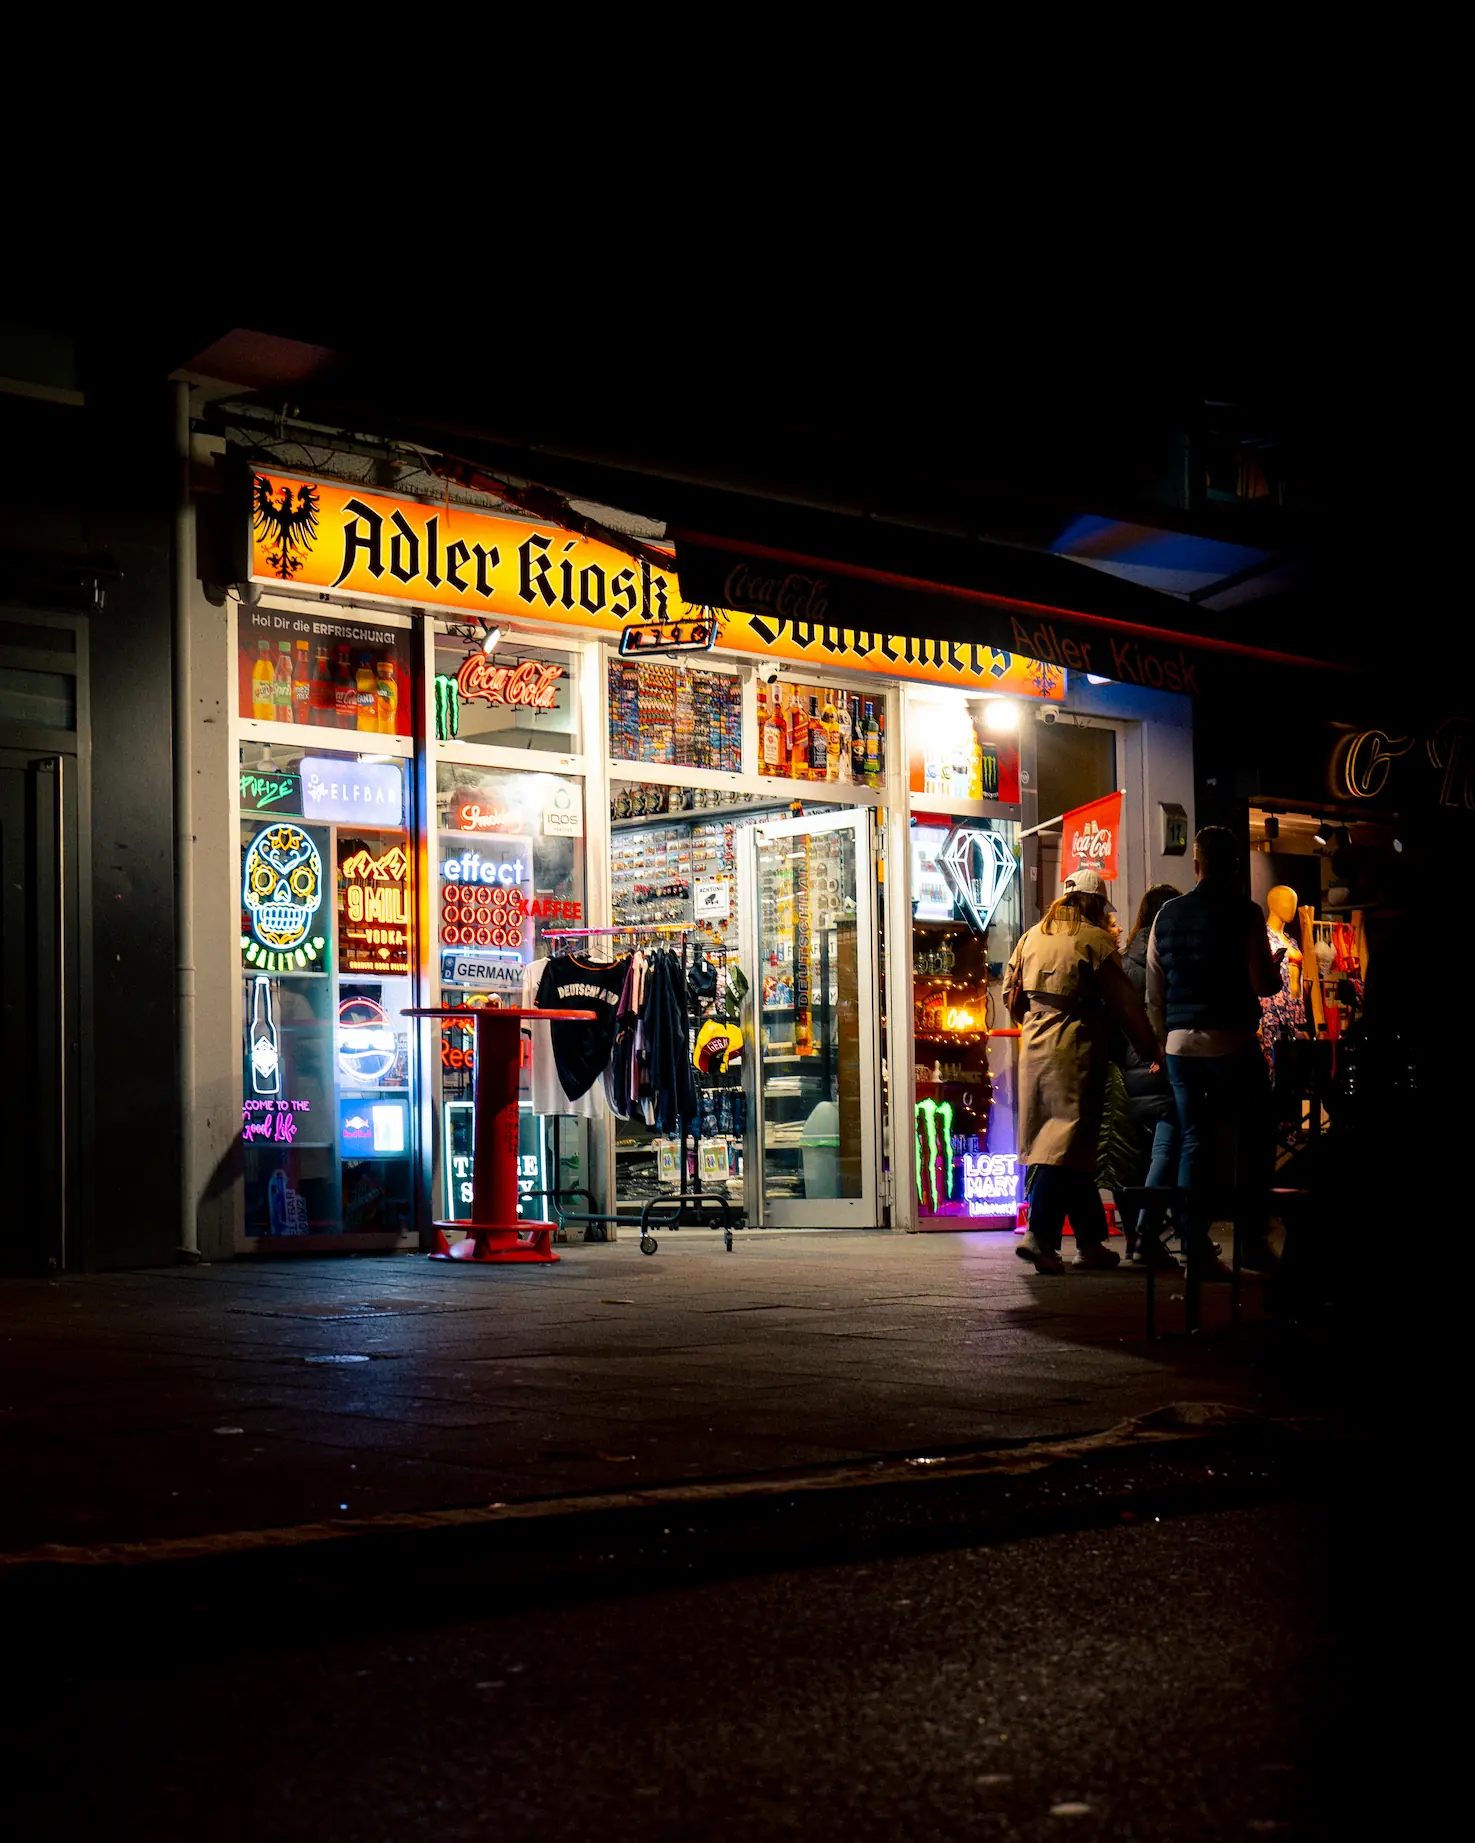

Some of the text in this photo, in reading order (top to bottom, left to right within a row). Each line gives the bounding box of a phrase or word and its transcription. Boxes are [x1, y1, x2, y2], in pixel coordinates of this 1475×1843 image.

[330, 497, 669, 621] Adler Kiosk
[252, 613, 396, 645] Hol Dir die ERFRISCHUNG!
[1009, 614, 1203, 698] Adler Kiosk
[547, 813, 579, 825] IQOS
[444, 852, 524, 884] effect
[347, 884, 364, 923] 9
[517, 898, 582, 920] KAFFEE
[365, 929, 403, 945] VODKA
[246, 940, 318, 972] SALITOS
[457, 962, 523, 982] GERMANY
[276, 1100, 289, 1111] TO
[290, 1100, 311, 1111] THE
[966, 1154, 1018, 1176] LOST
[966, 1175, 1020, 1198] MARY
